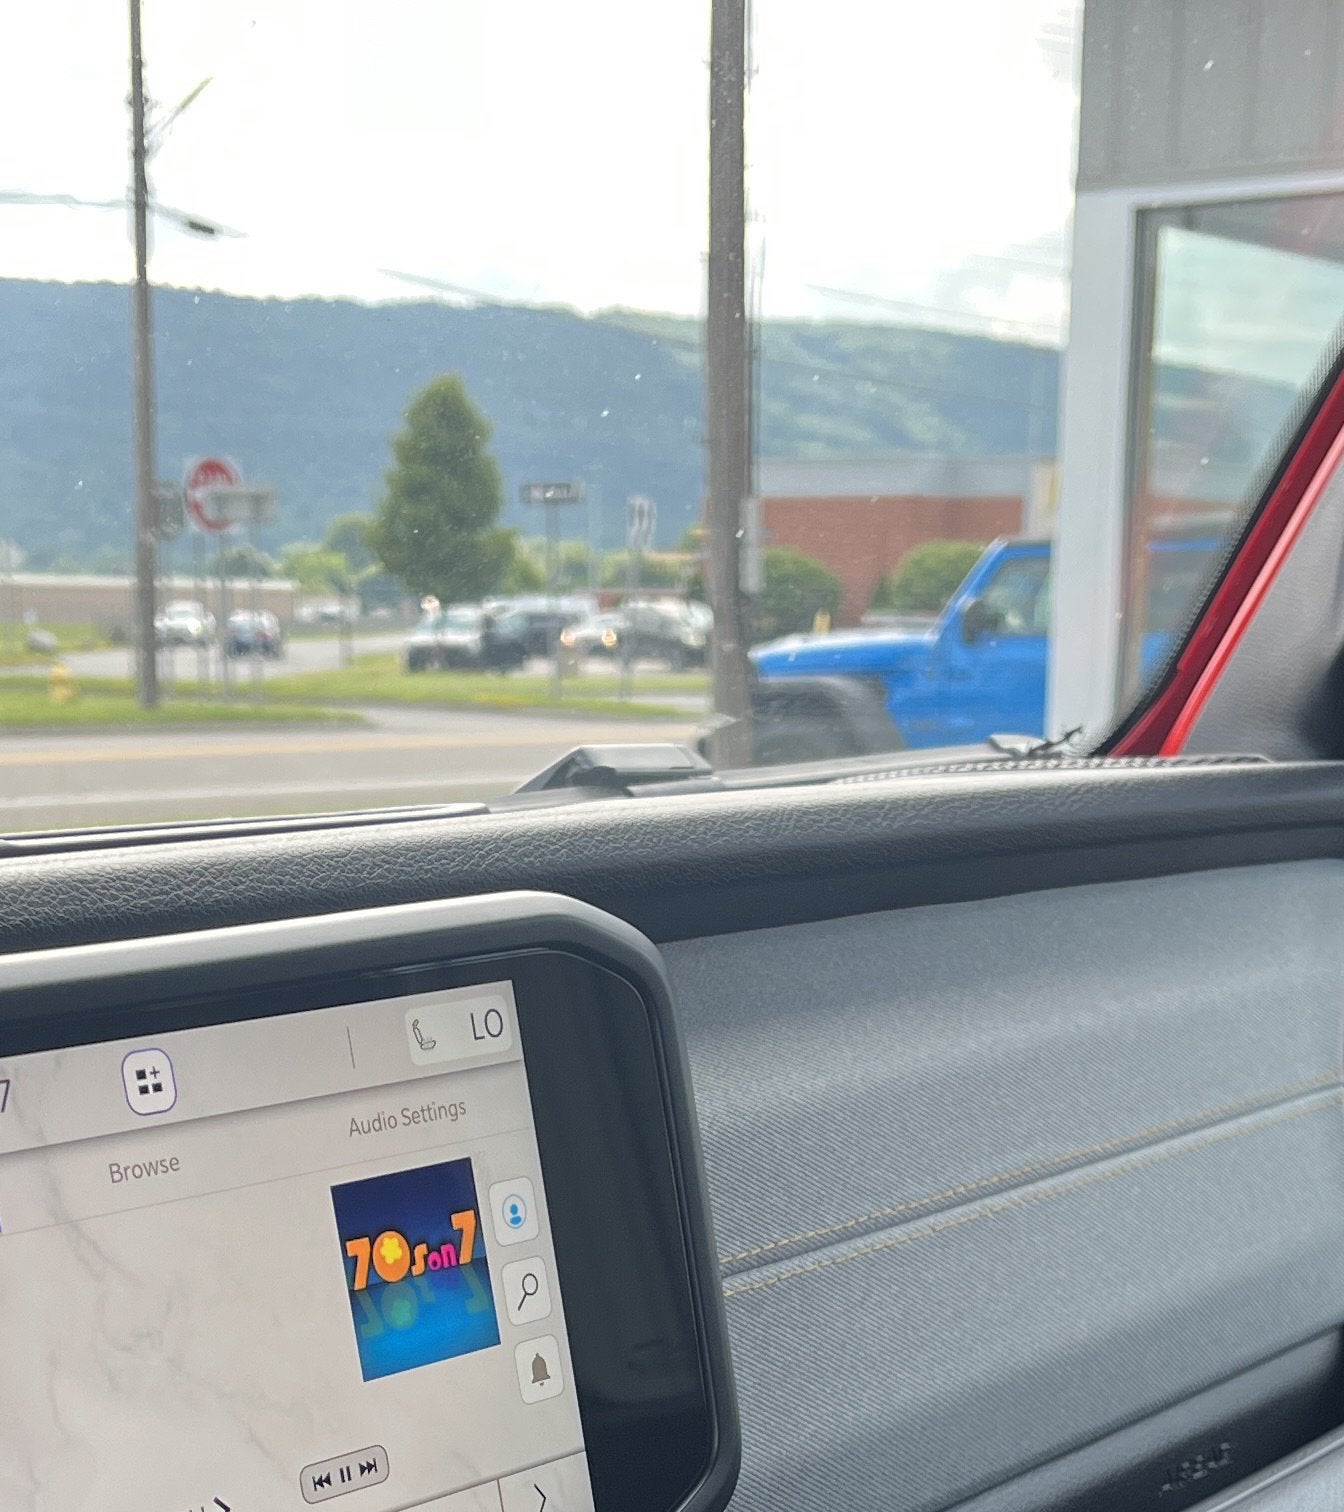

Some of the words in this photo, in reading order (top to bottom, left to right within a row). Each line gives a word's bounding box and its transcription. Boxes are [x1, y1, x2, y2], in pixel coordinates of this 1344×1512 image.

[471, 1008, 504, 1041] LO
[349, 1108, 398, 1137] Audio
[401, 1098, 467, 1129] Settings
[108, 1154, 181, 1184] Browse
[428, 1242, 456, 1272] on
[451, 1209, 477, 1266] 7
